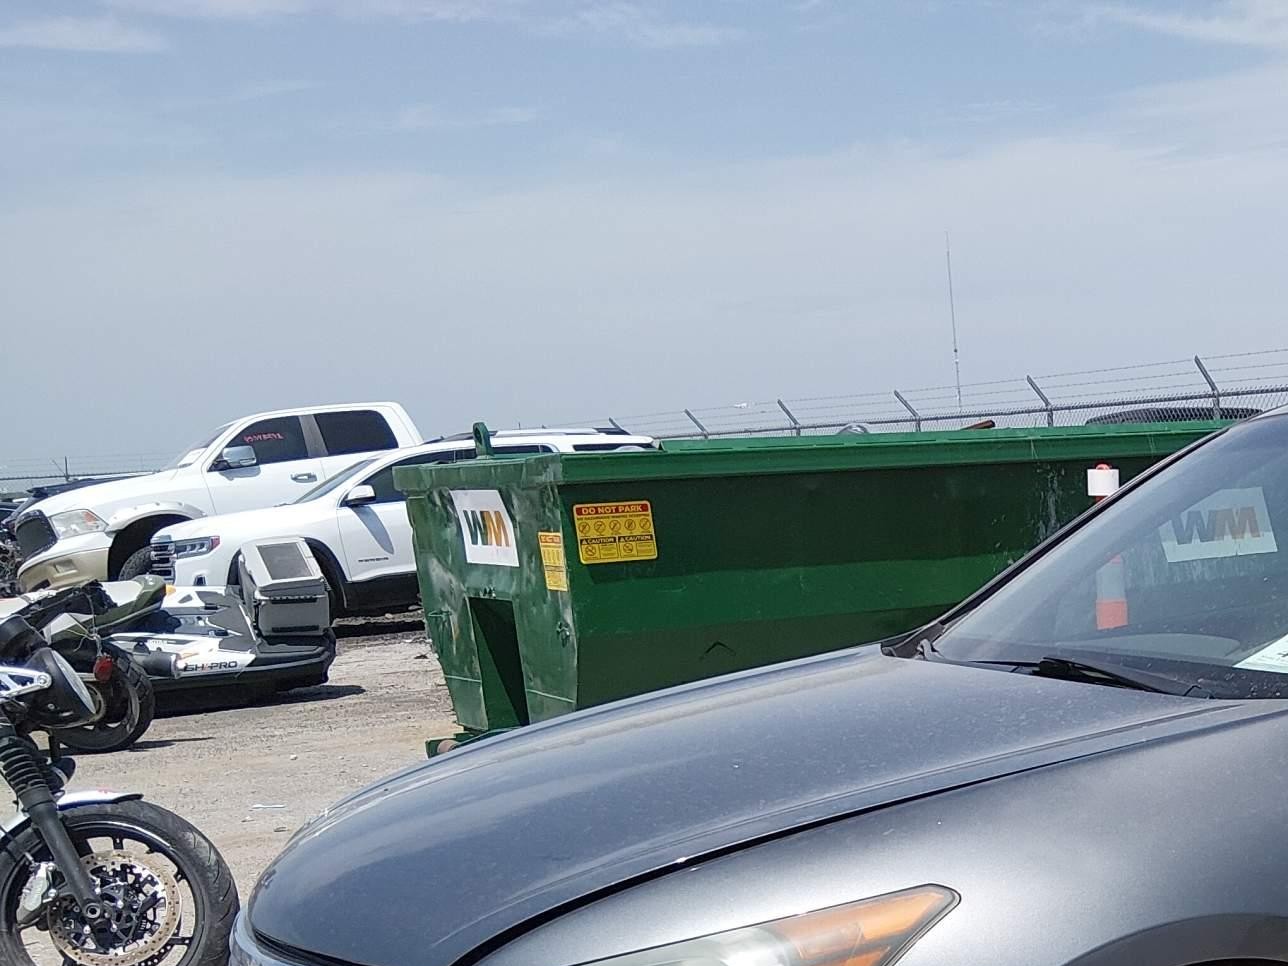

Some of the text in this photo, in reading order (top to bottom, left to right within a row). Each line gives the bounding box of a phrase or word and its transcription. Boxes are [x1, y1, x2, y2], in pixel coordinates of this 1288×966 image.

[581, 504, 643, 515] DO NOT PARK
[463, 510, 508, 547] WM
[626, 534, 652, 542] CAUTION
[1171, 507, 1261, 545] WM
